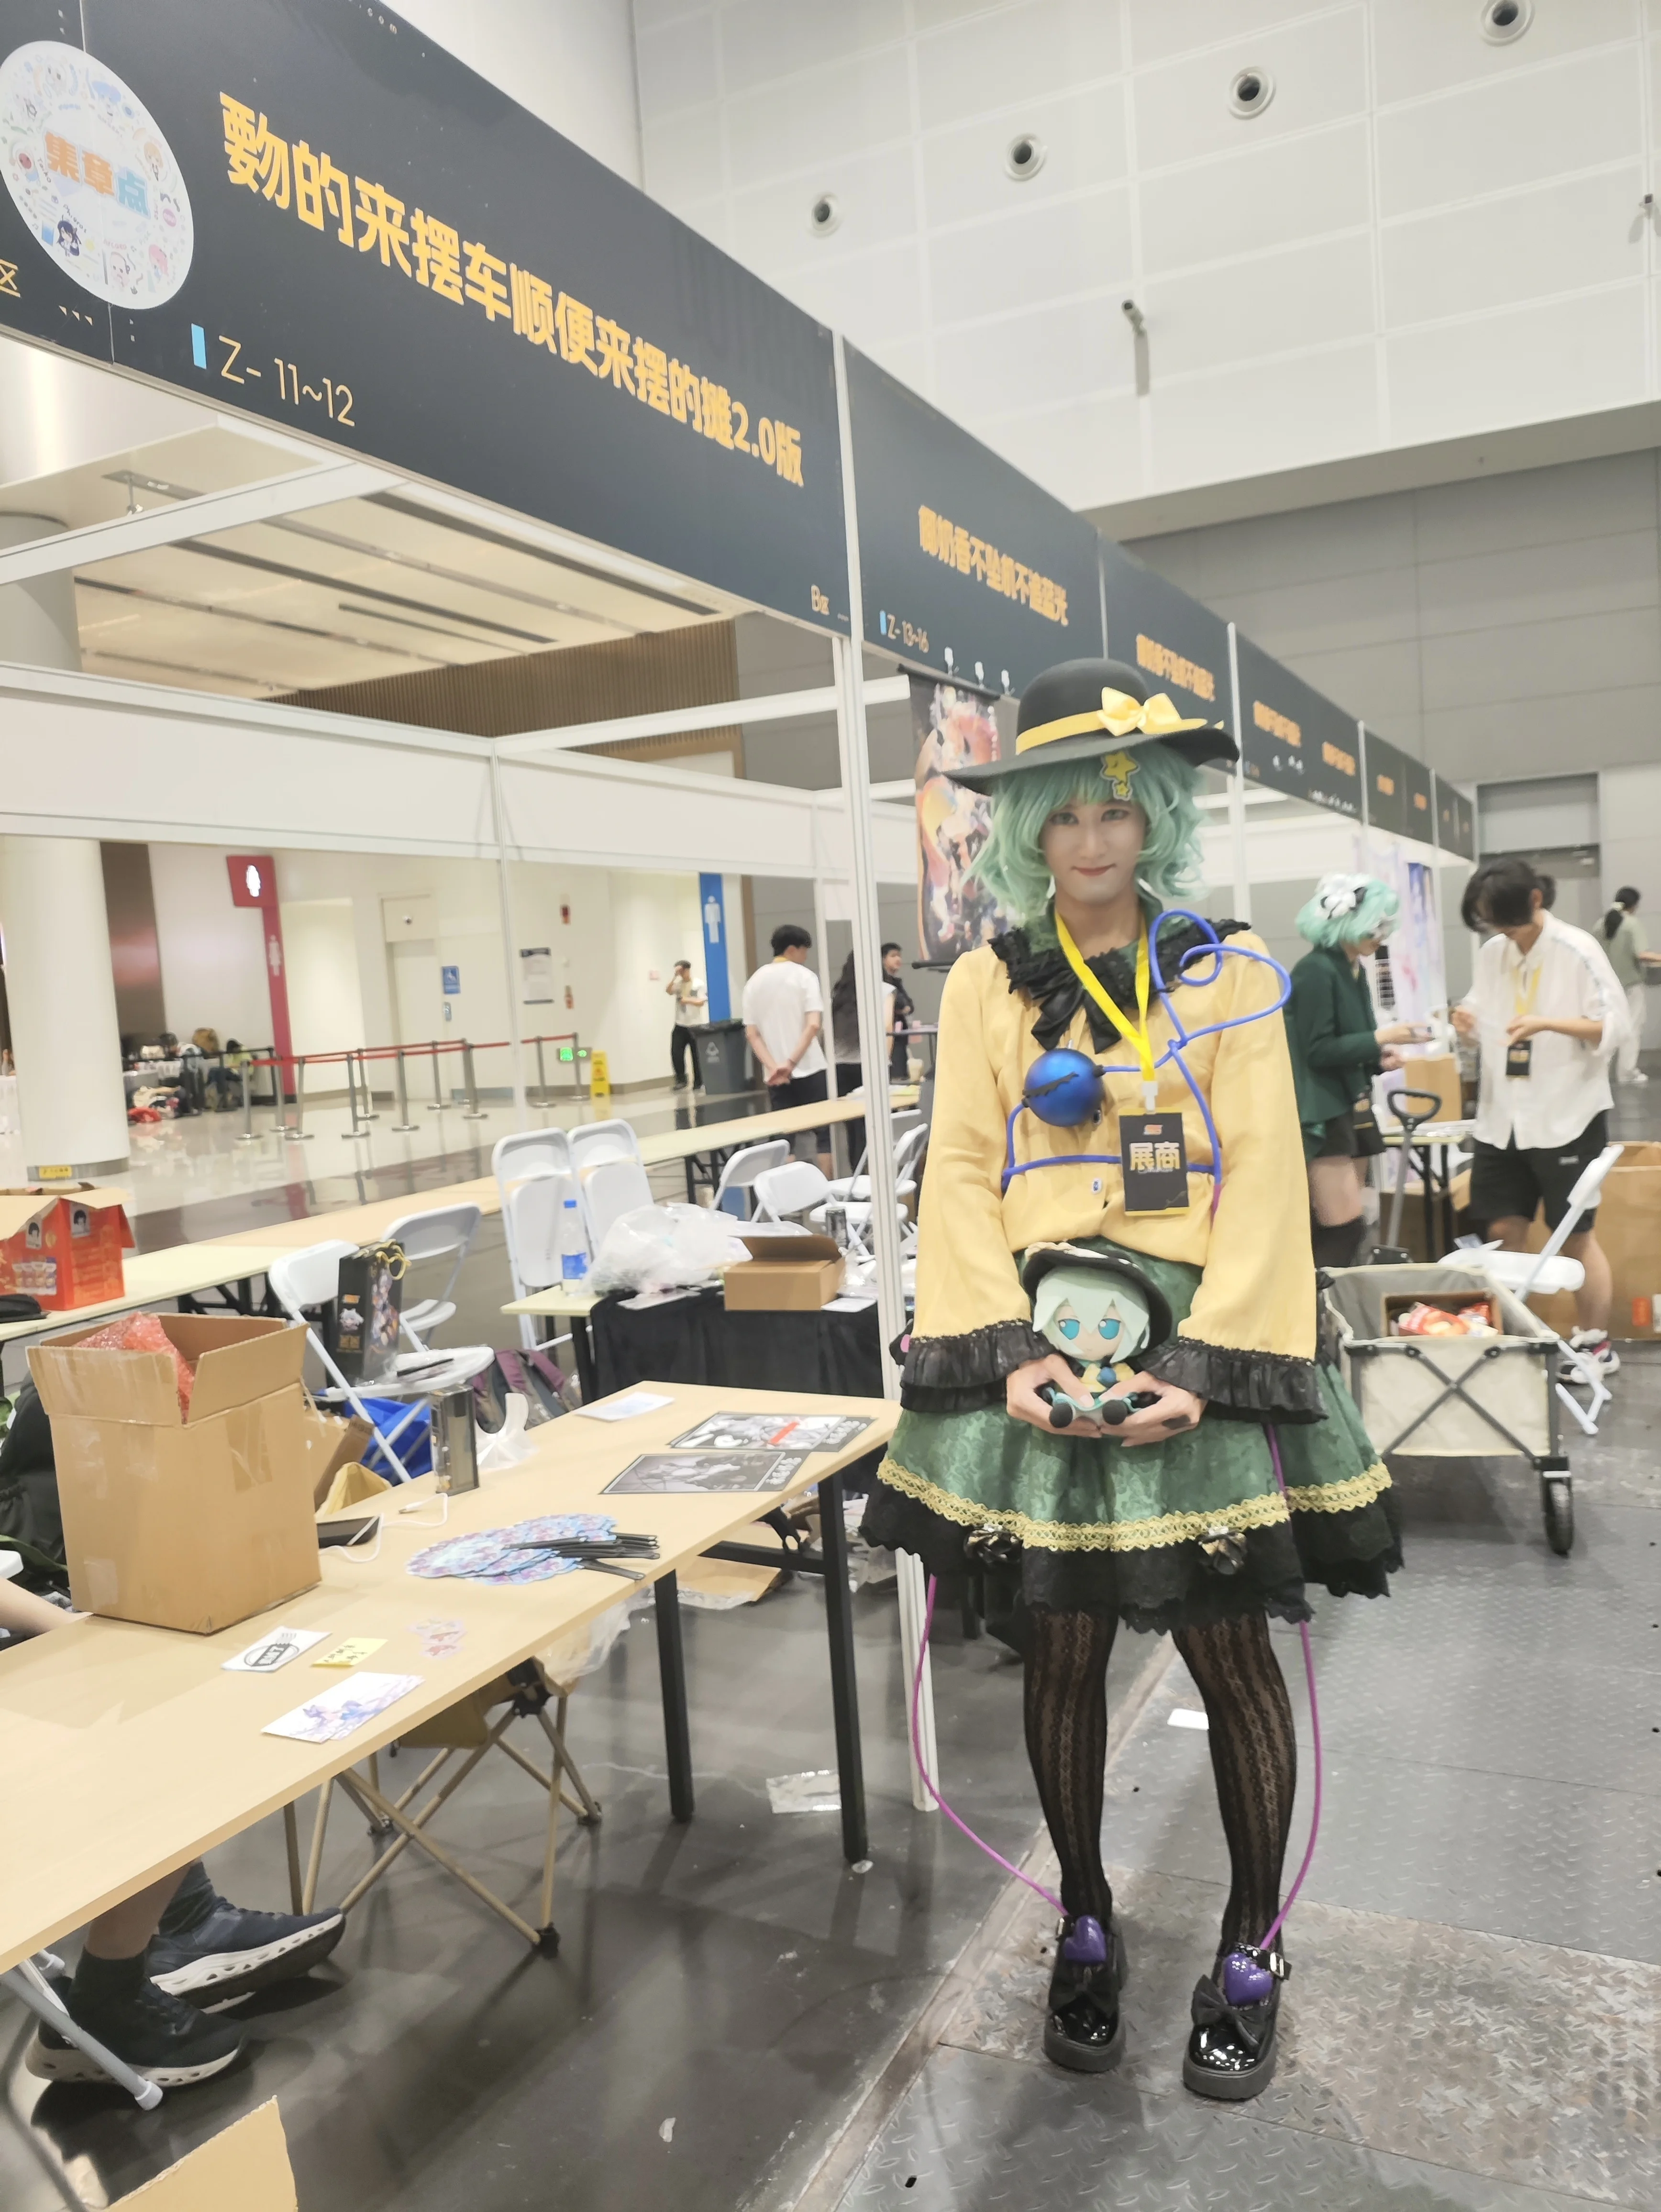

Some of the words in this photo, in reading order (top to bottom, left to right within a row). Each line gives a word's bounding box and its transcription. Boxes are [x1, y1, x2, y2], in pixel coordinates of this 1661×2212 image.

[44, 131, 150, 218] 集章点
[1129, 1141, 1181, 1171] 展商
